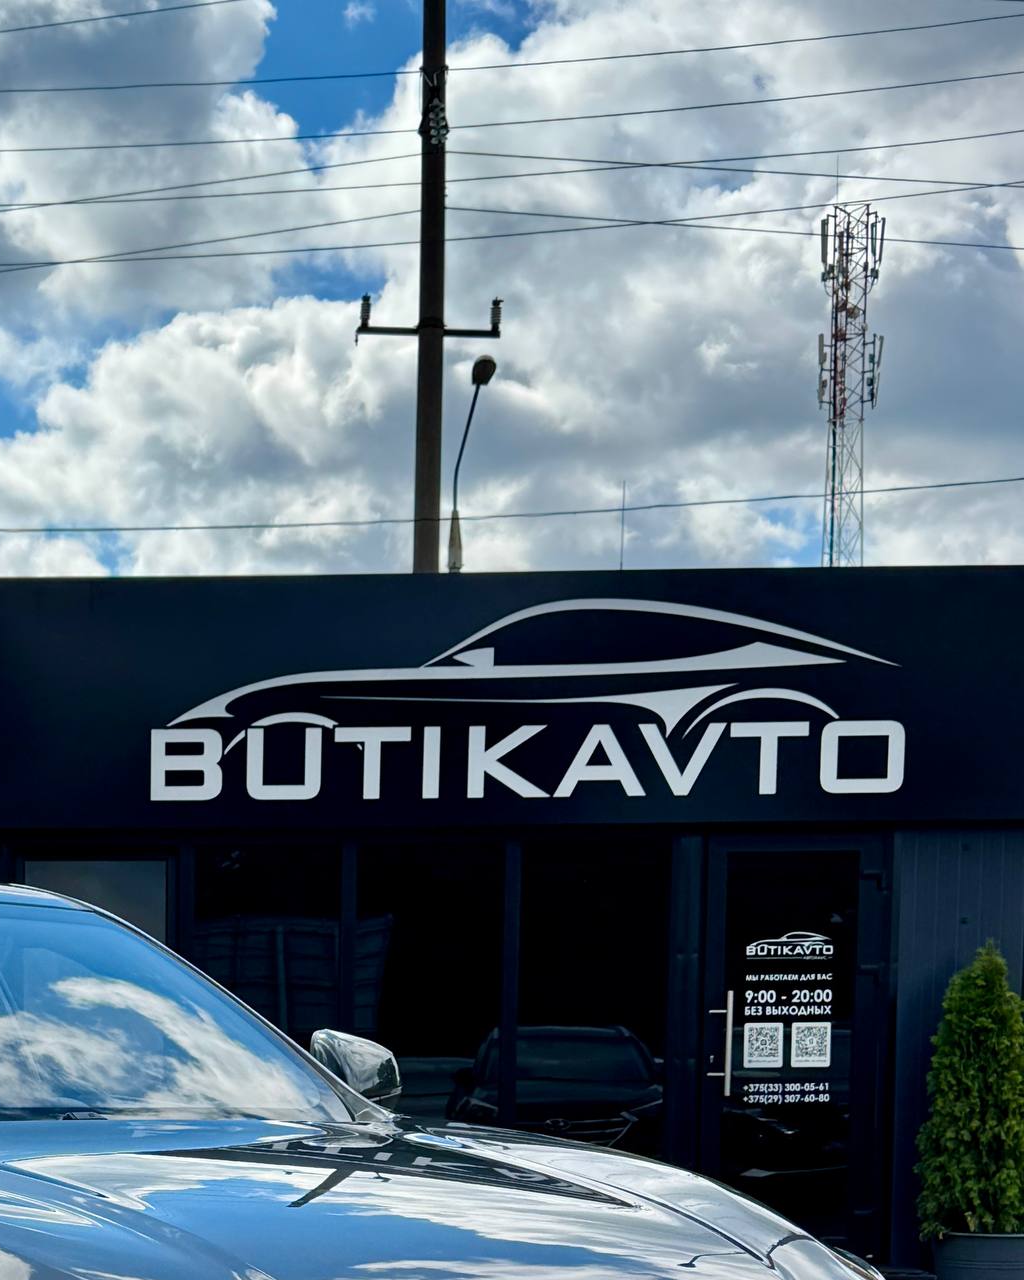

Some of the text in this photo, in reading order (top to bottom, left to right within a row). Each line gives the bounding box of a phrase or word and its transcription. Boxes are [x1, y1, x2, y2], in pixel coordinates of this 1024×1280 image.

[149, 719, 907, 801] BUTIKAVTO
[746, 945, 834, 956] BUTIKAVTO
[800, 973, 816, 981] ДЛЯ
[745, 990, 777, 1003] 9:00
[791, 989, 833, 1003] 20:00
[744, 1005, 832, 1016] БЕЗ ВЫХОДНЫХ
[743, 1082, 830, 1093] +375(33) 300-05-61
[743, 1094, 831, 1105] +375(29) 307-60-80
